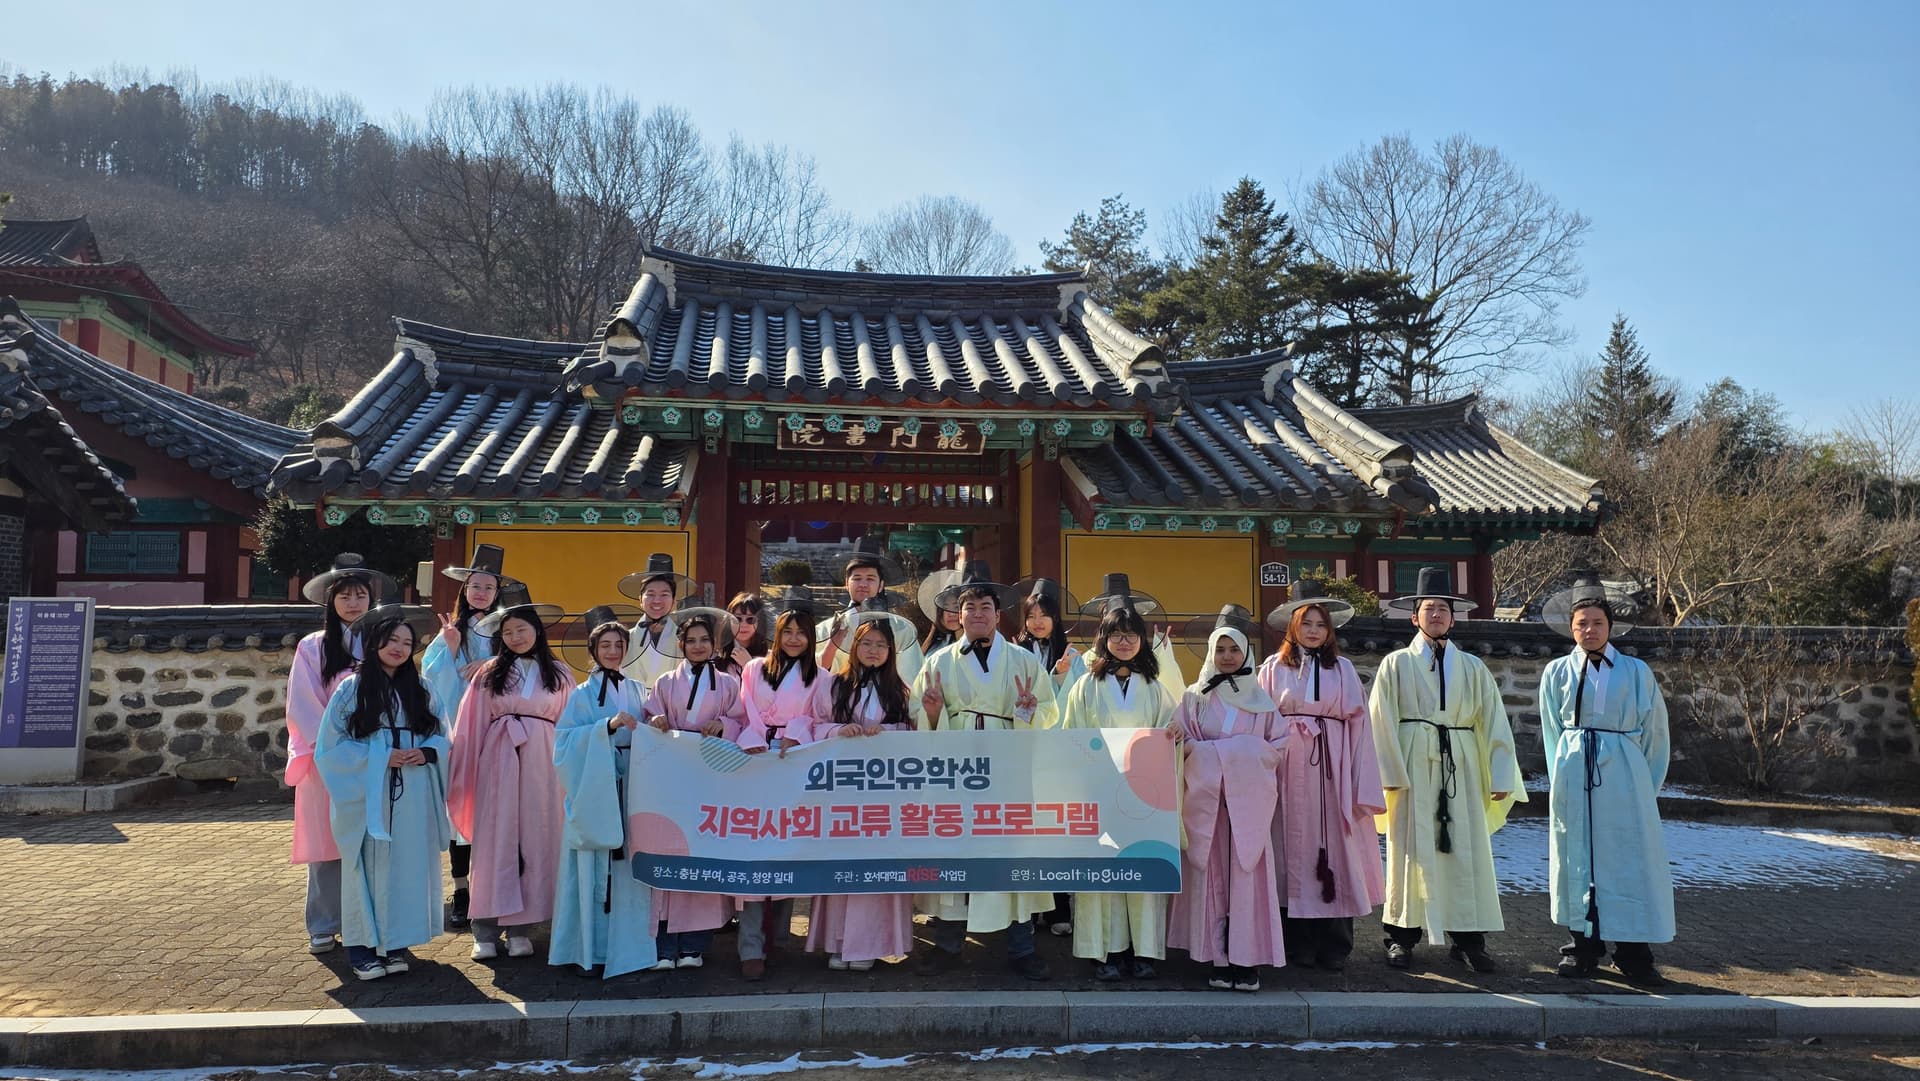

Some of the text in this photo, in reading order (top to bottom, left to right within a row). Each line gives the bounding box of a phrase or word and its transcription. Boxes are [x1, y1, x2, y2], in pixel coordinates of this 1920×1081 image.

[1264, 574, 1286, 583] 54-12
[804, 757, 991, 791] 외국인유학생
[698, 803, 1100, 840] 지역사회 교류 활동 프로그램
[680, 868, 699, 880] 충남
[701, 869, 725, 883] 부여,
[727, 871, 750, 885] 공주,
[752, 871, 772, 884] 청양
[774, 871, 794, 884] 일대
